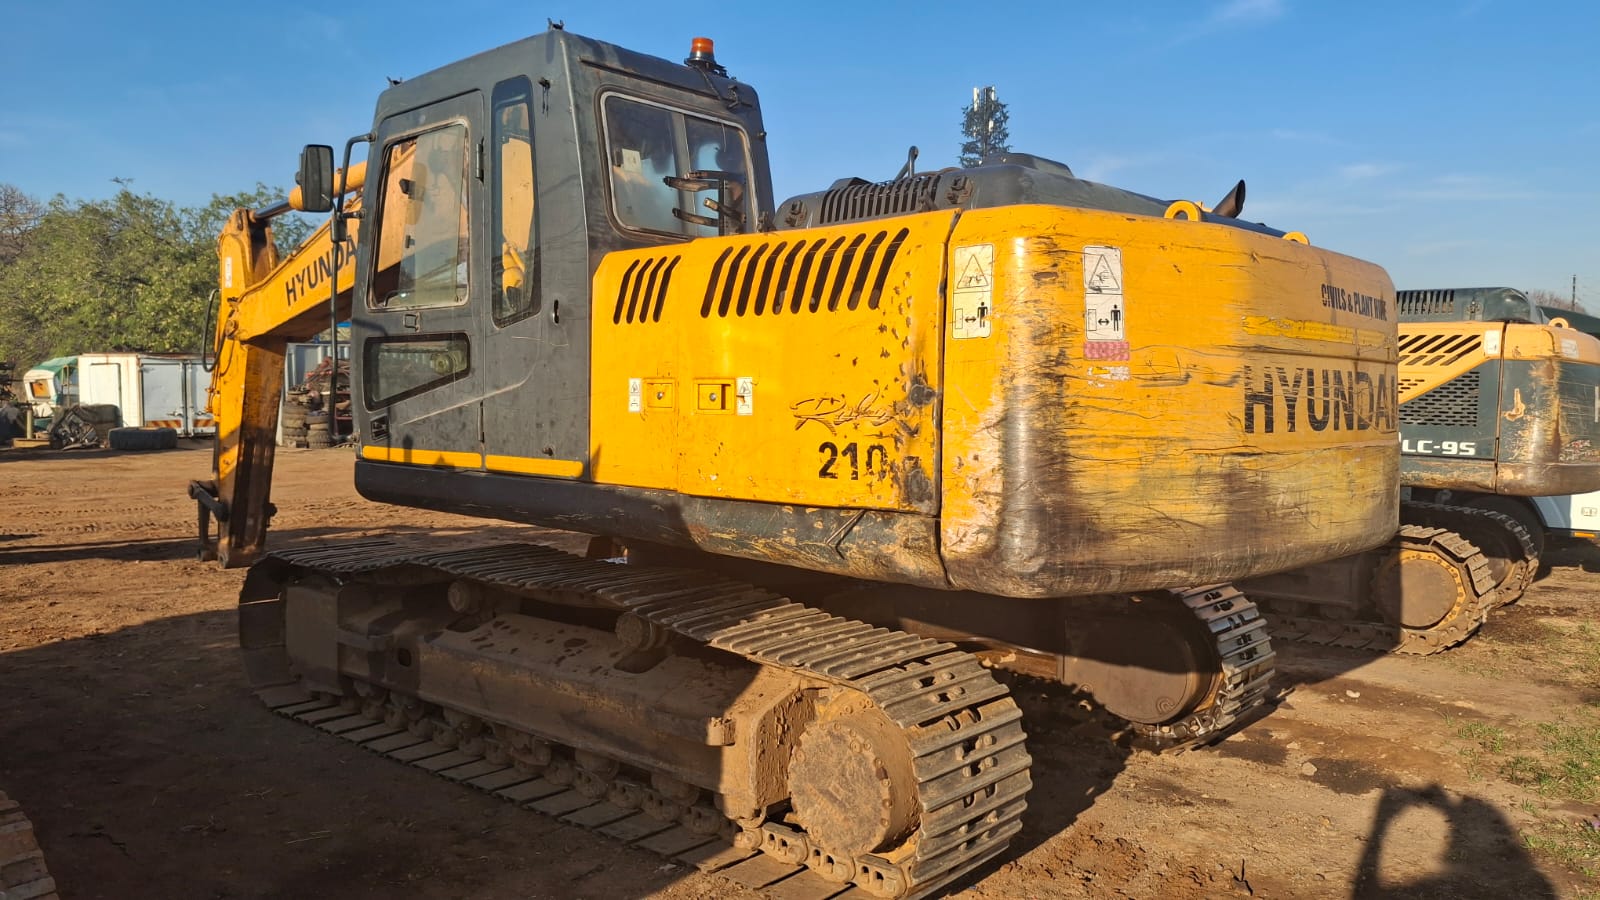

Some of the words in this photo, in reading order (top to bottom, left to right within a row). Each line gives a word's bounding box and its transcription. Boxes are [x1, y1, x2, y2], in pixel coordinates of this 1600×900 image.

[285, 234, 358, 307] HYUNDA
[1321, 283, 1347, 311] CIVILS
[1347, 293, 1354, 313] &
[1353, 291, 1374, 318] PLANT
[1243, 365, 1396, 434] HYUNDAI
[818, 441, 889, 481] 210
[1399, 431, 1476, 456] LC-9S
